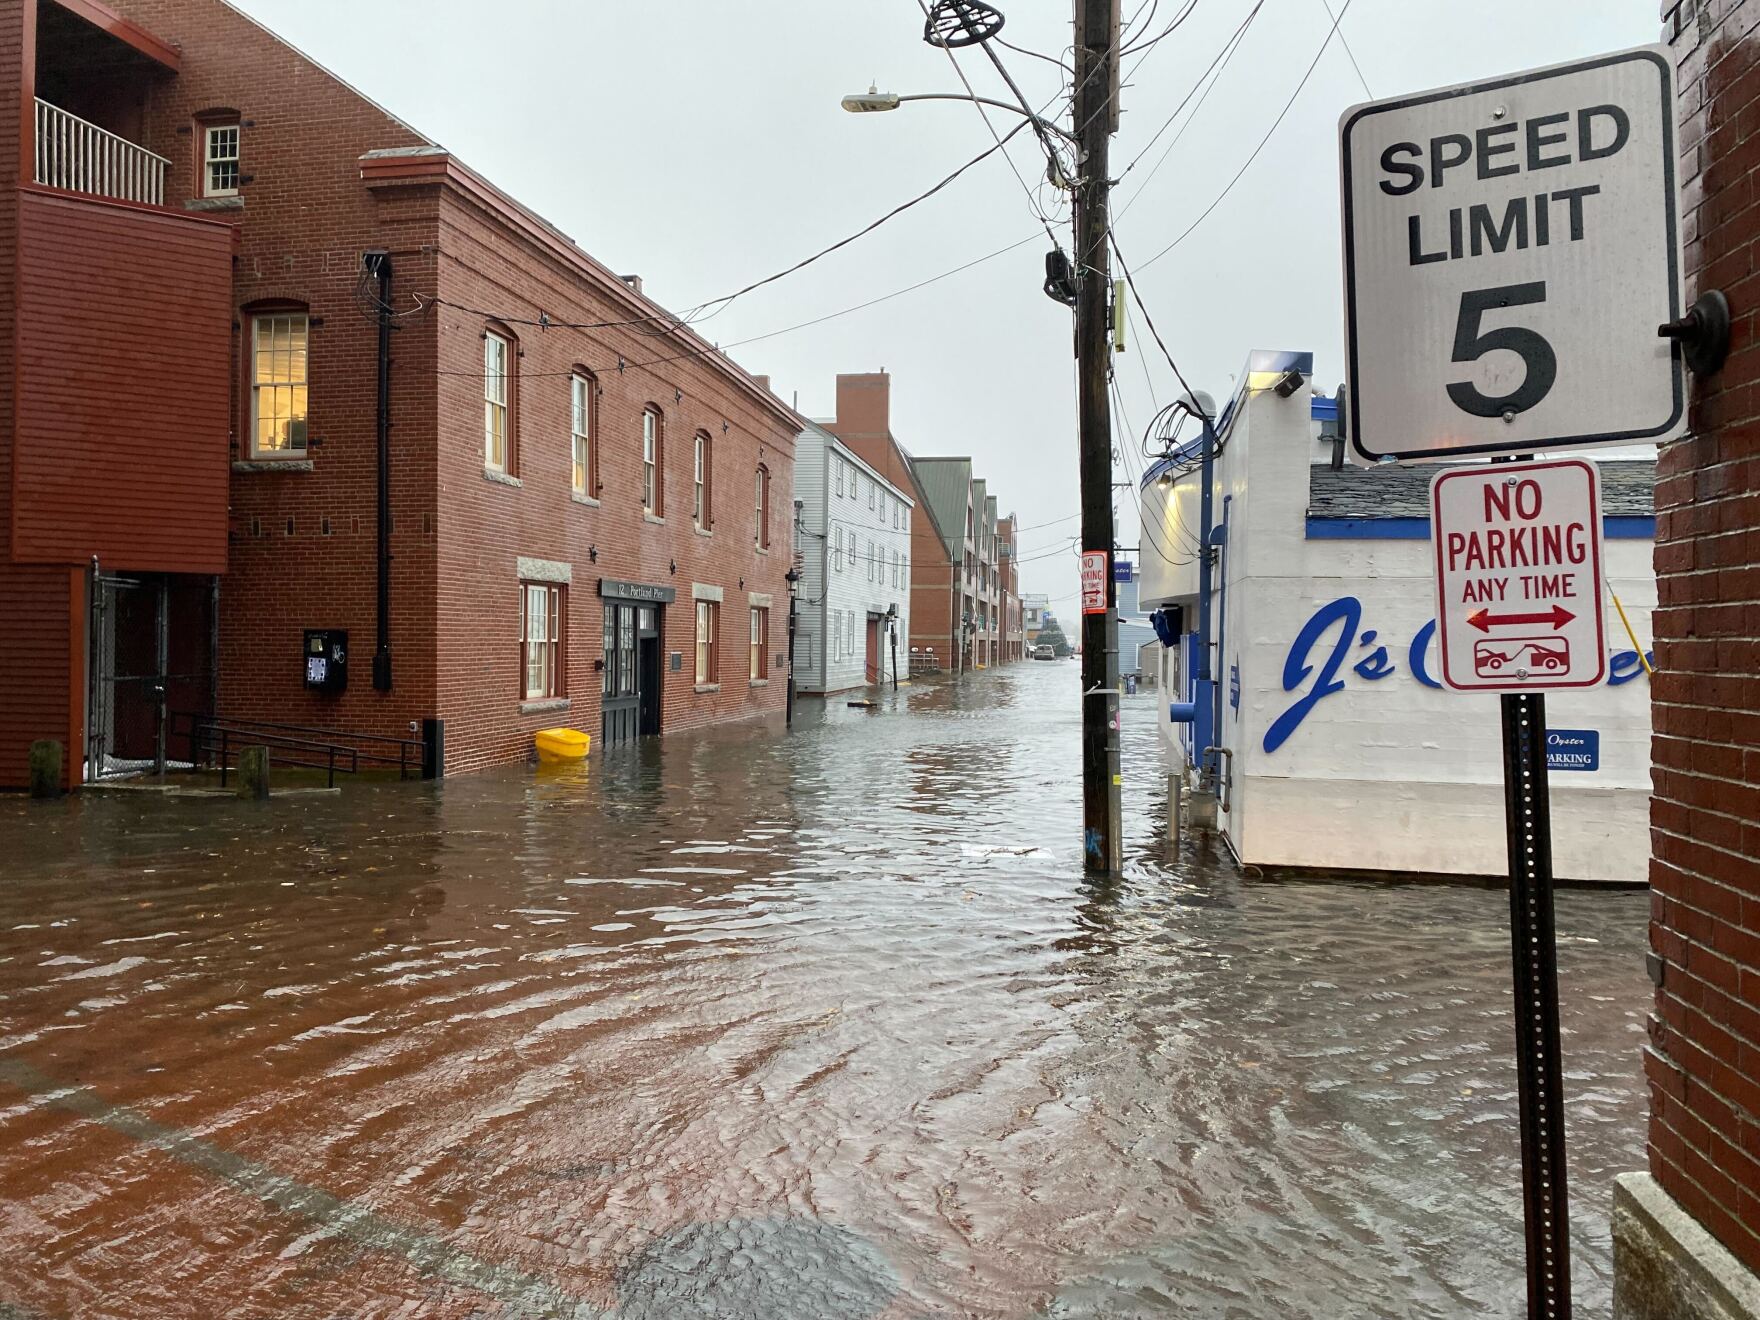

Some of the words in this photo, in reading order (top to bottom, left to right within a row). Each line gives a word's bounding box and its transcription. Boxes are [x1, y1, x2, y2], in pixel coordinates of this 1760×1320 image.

[1379, 104, 1630, 196] SPEED
[1408, 184, 1600, 266] LIMIT
[1445, 280, 1557, 418] 5
[1484, 479, 1542, 523] NO
[1083, 558, 1094, 569] NO
[1448, 522, 1586, 572] PARKING
[618, 584, 625, 595] 12
[630, 585, 652, 598] Portland
[653, 588, 664, 598] Pier
[1462, 577, 1509, 603] ANY
[1520, 573, 1577, 600] TIME
[1262, 596, 1396, 753] J's
[1548, 734, 1584, 746] Oyster
